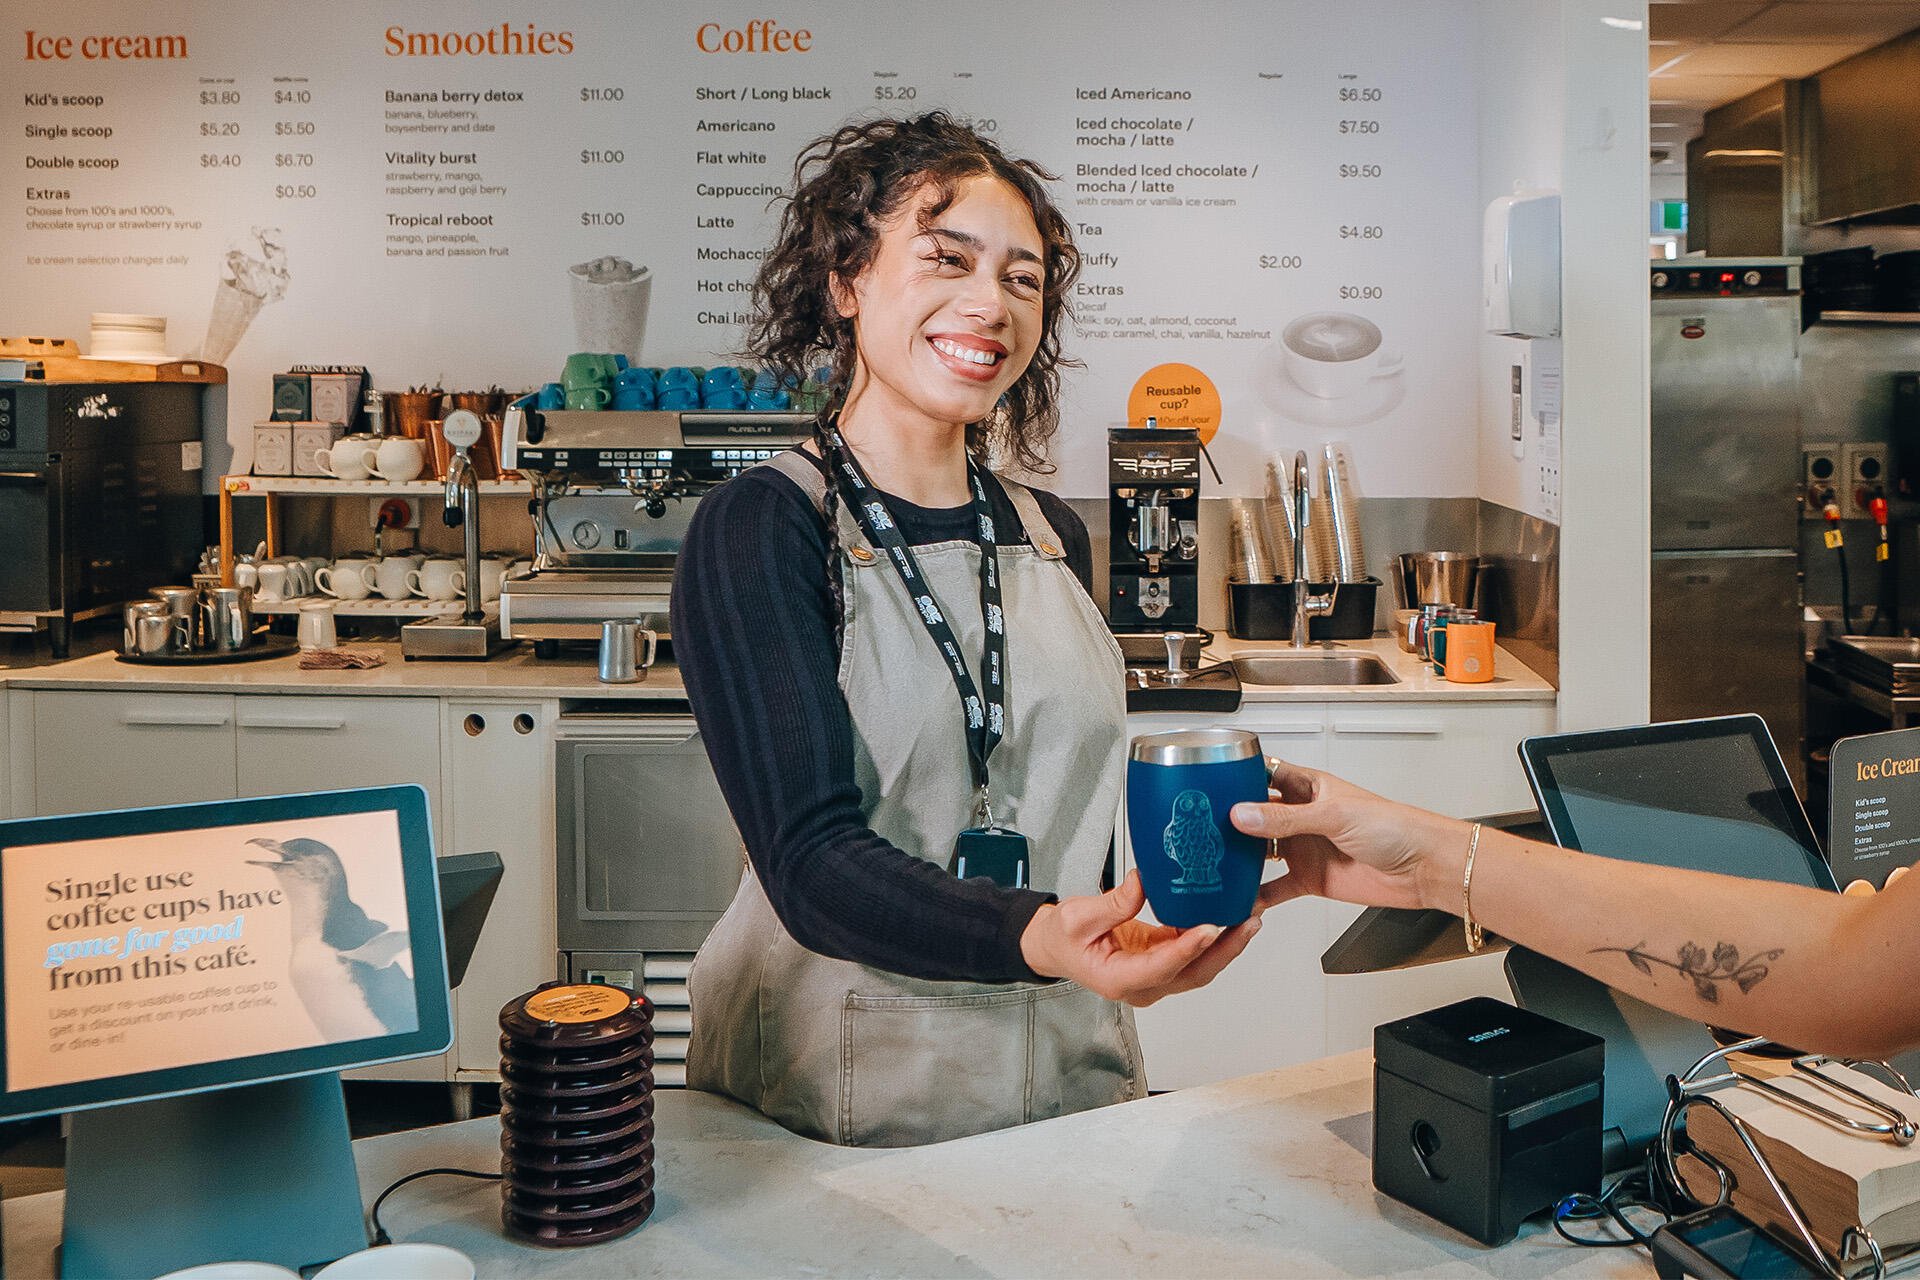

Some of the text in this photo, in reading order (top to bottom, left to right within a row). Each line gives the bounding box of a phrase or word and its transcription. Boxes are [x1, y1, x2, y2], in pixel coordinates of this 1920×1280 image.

[385, 23, 574, 56] Smoothies
[696, 20, 812, 53] Coffee
[25, 30, 188, 60] Ice cream
[200, 90, 240, 105] $3.80
[274, 90, 311, 104] $4.10
[385, 89, 524, 104] Banana berry detox
[580, 87, 624, 102] $11.00
[696, 87, 831, 103] Short Long black
[874, 86, 917, 100] $5.20
[1076, 87, 1192, 100] Iced Americano
[1339, 87, 1382, 102] $6.50
[25, 93, 104, 108] Kid's scoop
[200, 122, 240, 136] $5.20
[275, 122, 315, 136] $5.50
[385, 122, 496, 135] boysenberry and date
[696, 119, 776, 132] Americano
[1076, 117, 1182, 130] Iced chocolate
[1339, 120, 1380, 134] $7.50
[25, 124, 113, 140] Single scoop
[1076, 133, 1174, 146] mocha latte
[26, 156, 119, 170] Double scoop
[200, 153, 241, 168] $6.40
[275, 153, 314, 168] $6.70
[385, 151, 477, 167] Vitality burst
[580, 149, 624, 164] $11.00
[697, 151, 766, 164] Flat white
[1076, 164, 1247, 177] Blended Iced chocolate
[1339, 164, 1382, 178] $9.50
[26, 187, 70, 200] Extras
[276, 184, 316, 199] $0.50
[386, 184, 507, 196] raspberry and goji berry
[696, 183, 783, 199] Cappuccino
[1076, 180, 1174, 193] mocha latte
[1076, 196, 1236, 207] with cream or vanilla ice cream
[26, 206, 63, 217] Choose
[65, 206, 88, 216] from
[91, 205, 116, 216] 100's
[118, 206, 137, 216] and
[26, 220, 202, 232] chocolate syrup or strawberry syrup
[386, 213, 493, 228] Tropical reboot
[581, 212, 625, 226] $11.00
[697, 216, 734, 228] Latte
[1076, 223, 1102, 236] Tea
[1339, 225, 1383, 239] $4.80
[386, 246, 509, 257] banana and passion fruit
[697, 248, 773, 260] Mochacci
[26, 255, 190, 267] Ice cream selection changes daily
[1259, 255, 1302, 269] $2.00
[697, 280, 723, 292] Hot
[1077, 283, 1124, 296] Extras
[1339, 285, 1383, 300] $0.90
[1076, 302, 1106, 312] Decaf
[697, 312, 729, 324] Chai
[1194, 317, 1237, 326] coconut
[1226, 329, 1271, 339] hazelnut
[1146, 384, 1201, 396] Reusable
[1160, 398, 1189, 411] cup?
[1857, 762, 1878, 781] Ice
[1855, 797, 1886, 807] Kid's scoop
[1855, 809, 1889, 820] Single scoop
[1854, 821, 1891, 832] Double scoop
[1854, 837, 1872, 845] Extras
[46, 870, 194, 904] Single use
[46, 889, 282, 932] coffee cups have
[43, 914, 244, 969] gone for good
[50, 944, 256, 991] from this café.
[48, 981, 278, 1020] Use your re-usable coffee cup to
[48, 995, 278, 1040] get a discount on your hot drink,
[49, 1032, 124, 1053] or dine-in!
